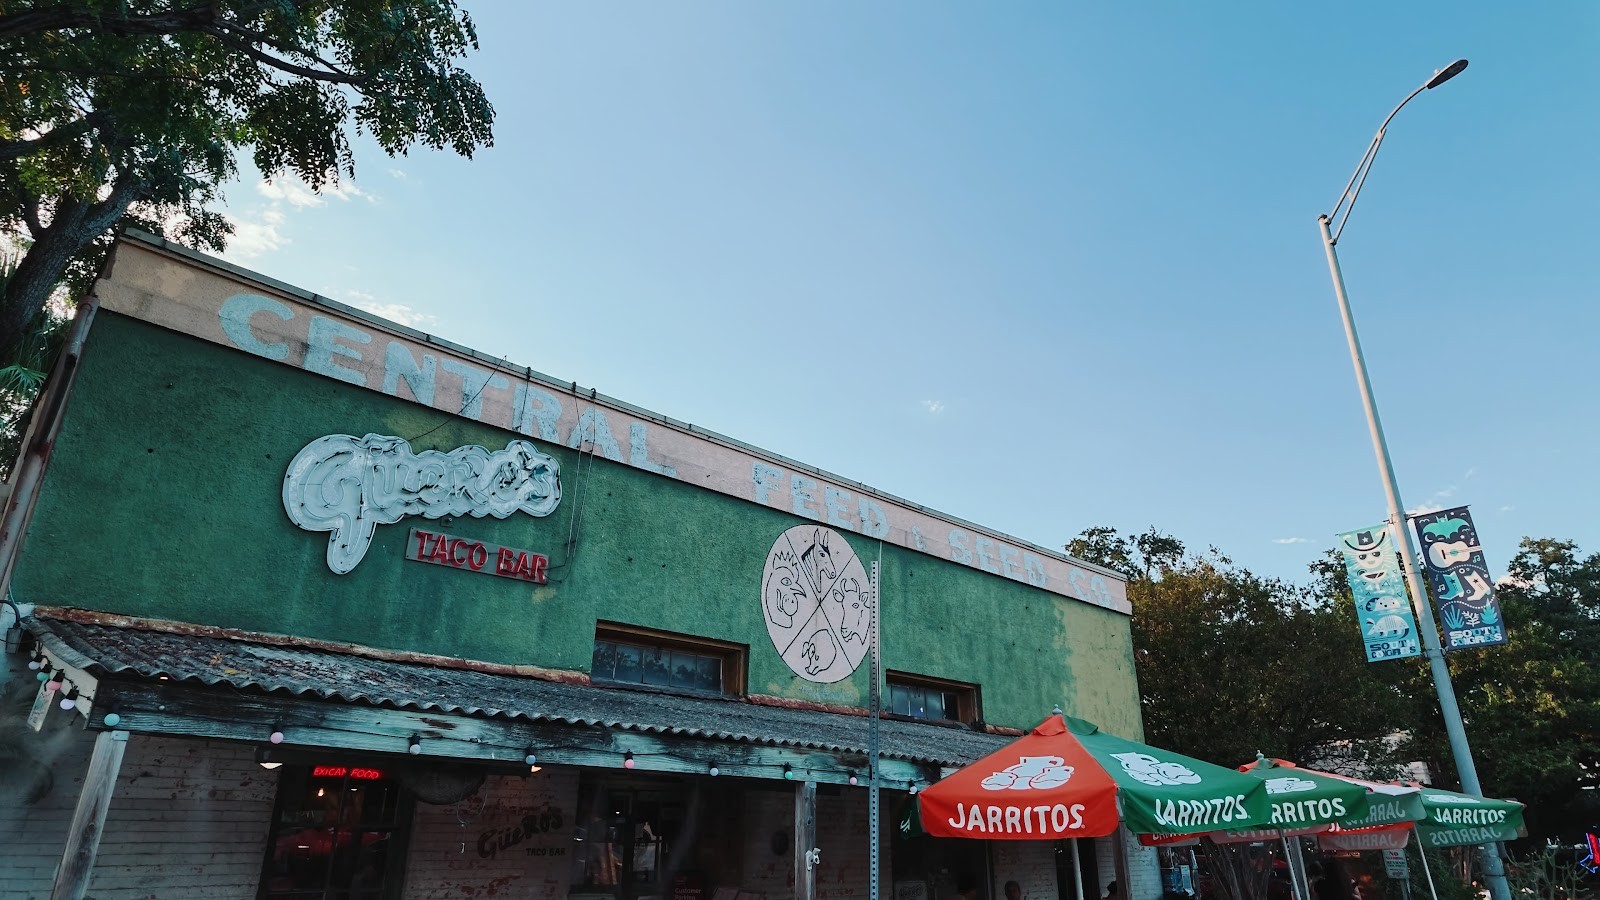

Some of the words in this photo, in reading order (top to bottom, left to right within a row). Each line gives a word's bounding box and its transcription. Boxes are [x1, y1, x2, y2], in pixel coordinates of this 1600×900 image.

[219, 293, 678, 476] CENTRAL
[752, 461, 889, 541] FEED
[948, 529, 1047, 589] SEED
[415, 530, 488, 571] TACO
[495, 547, 548, 583] BAR
[1370, 639, 1416, 651] SOUTH
[1449, 625, 1501, 640] SOUTH
[350, 767, 380, 780] FOOD
[948, 802, 1085, 834] JARRITOS
[1154, 795, 1250, 828] JARRITOS
[1268, 798, 1346, 824] RRITOS
[1434, 797, 1507, 825] JARRITOS
[526, 847, 546, 857] TACO
[548, 847, 566, 856] BAR
